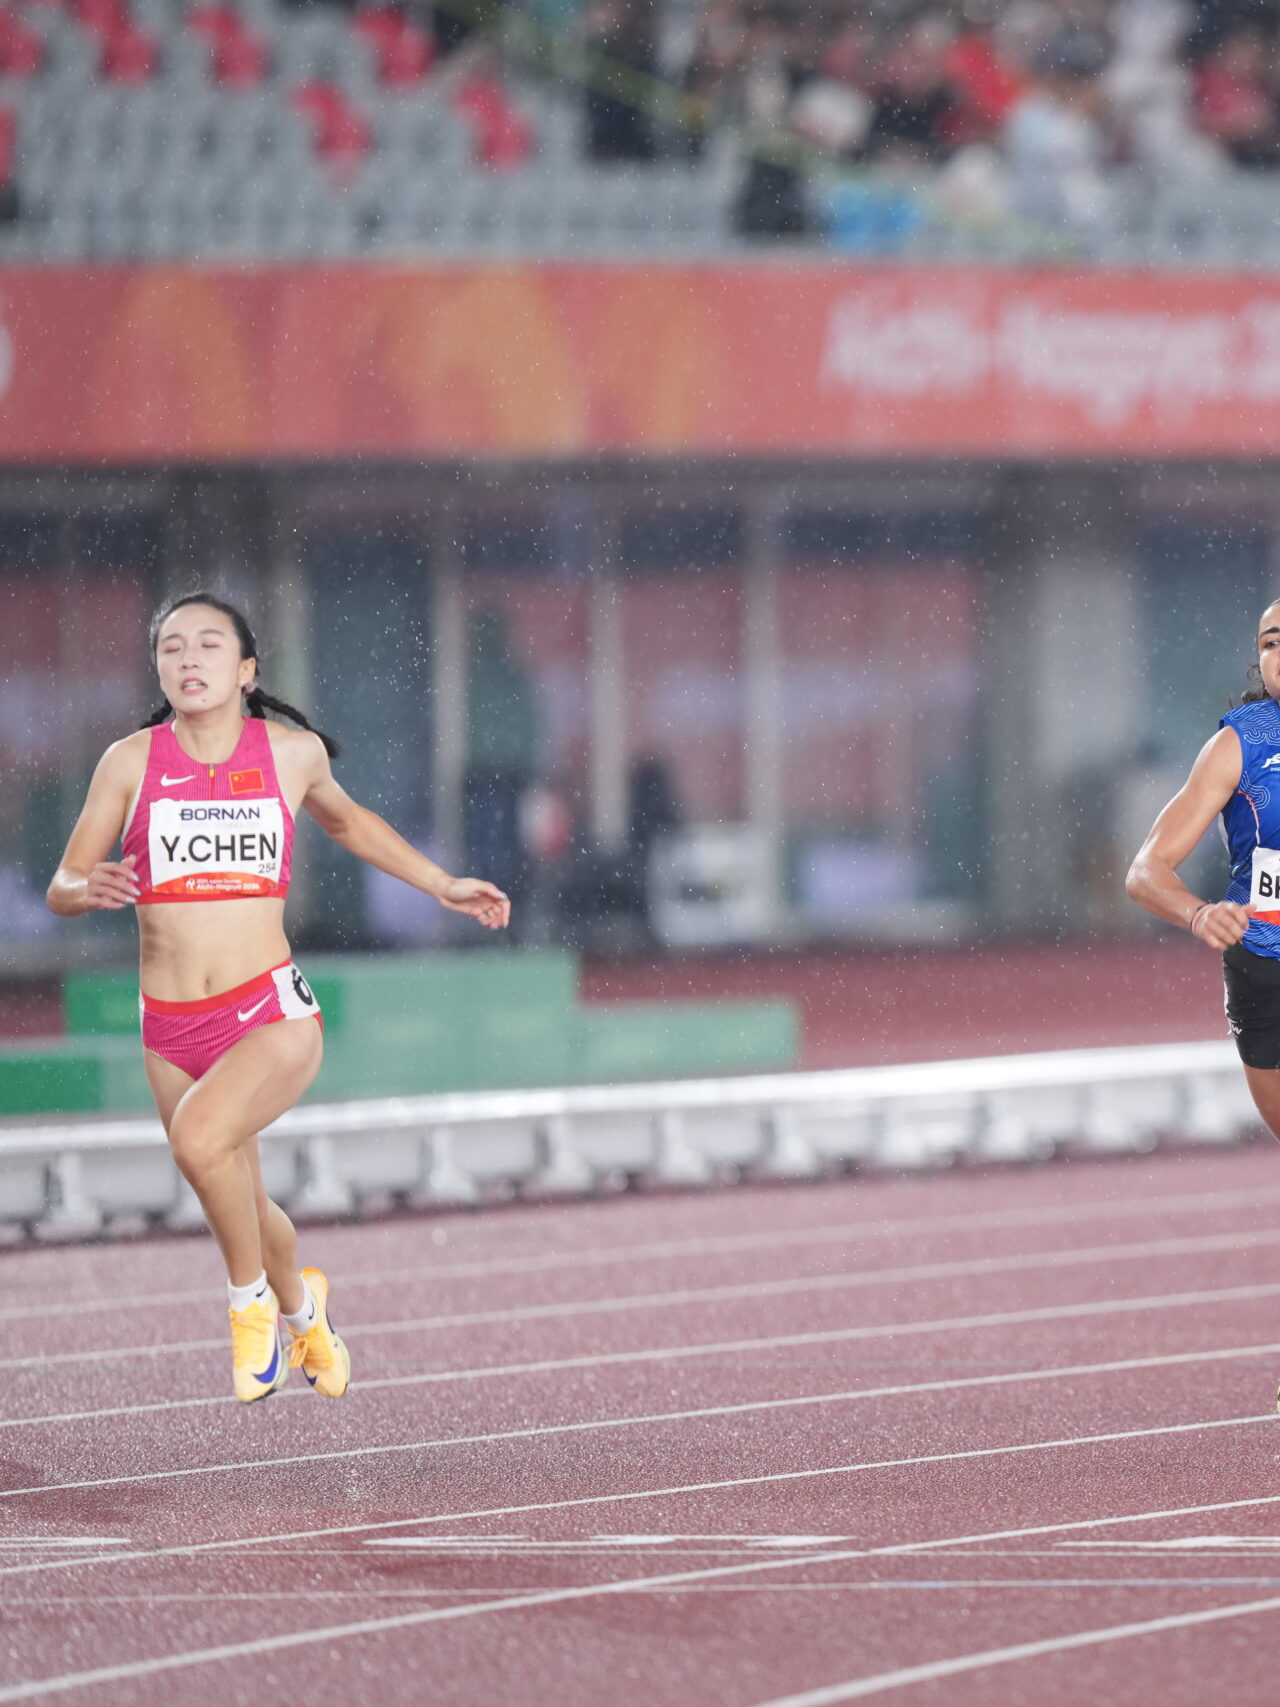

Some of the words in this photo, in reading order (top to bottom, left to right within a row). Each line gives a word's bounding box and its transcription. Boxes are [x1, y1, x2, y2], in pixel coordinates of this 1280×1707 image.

[179, 806, 260, 821] BORNAN
[160, 832, 277, 862] Y.CHEN
[258, 863, 276, 873] 254
[291, 968, 313, 1006] 6
